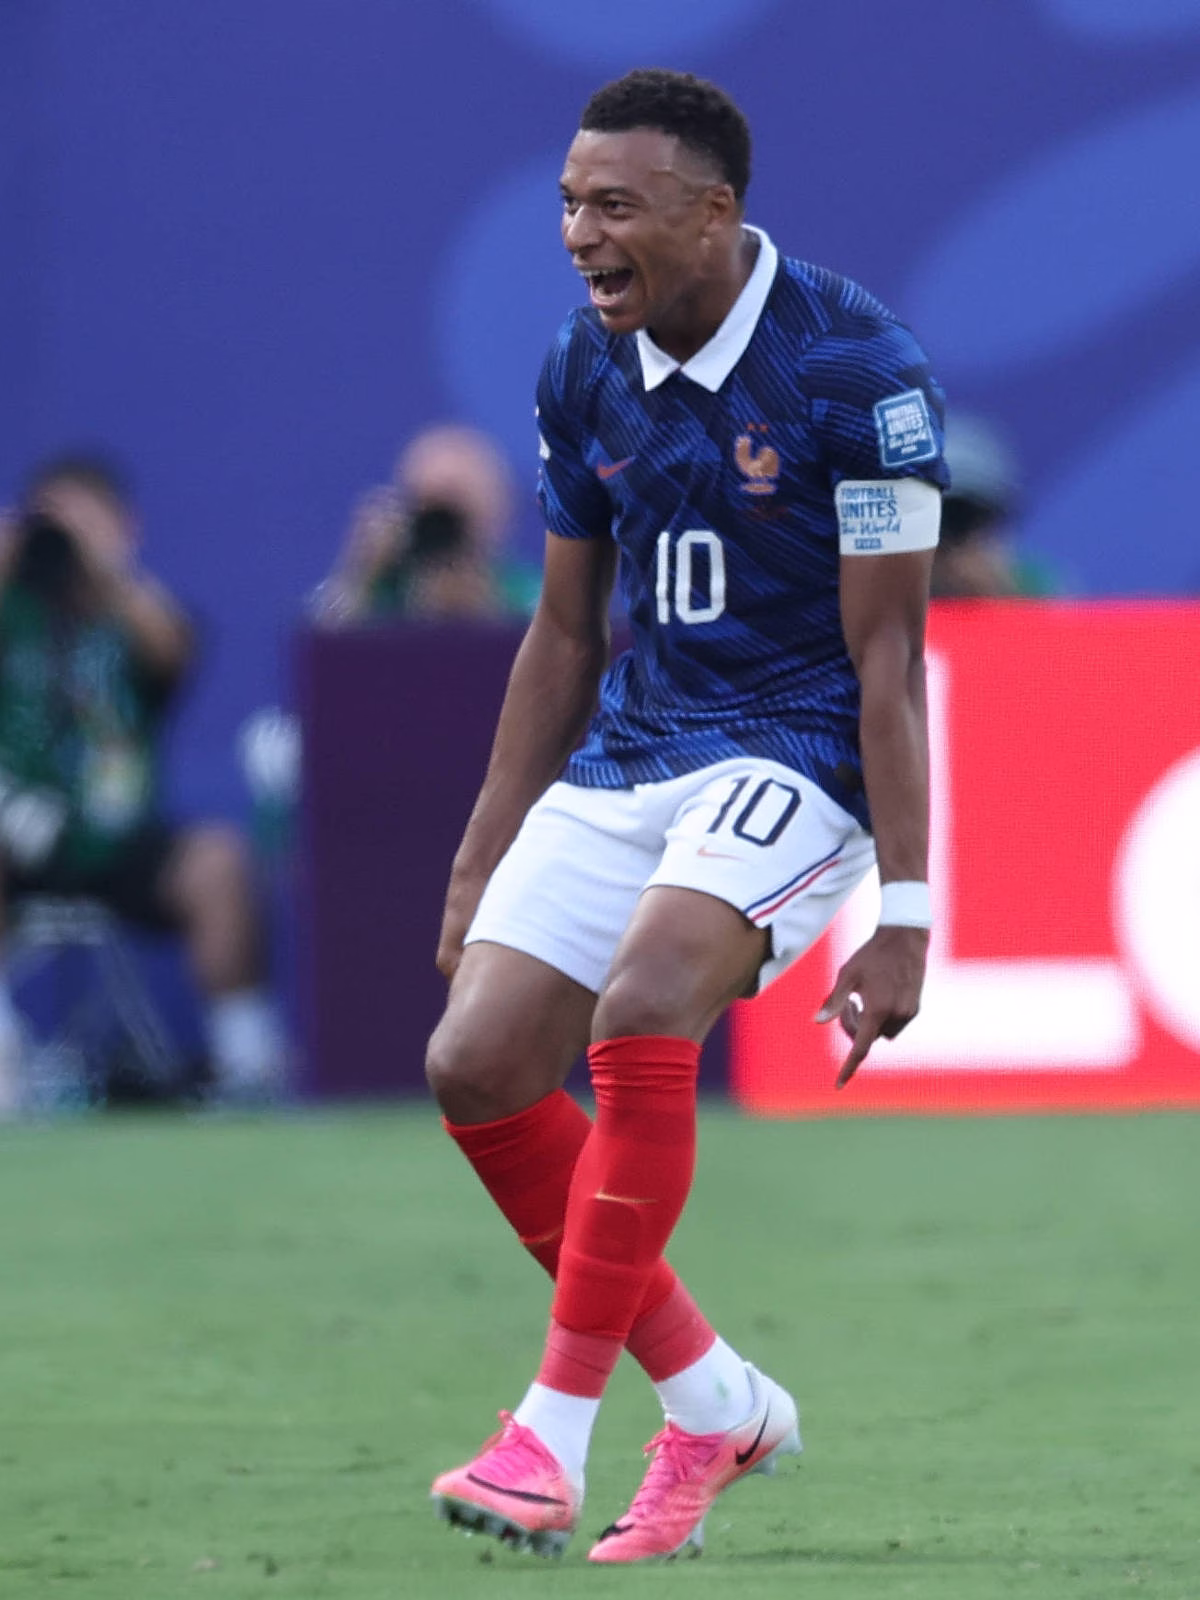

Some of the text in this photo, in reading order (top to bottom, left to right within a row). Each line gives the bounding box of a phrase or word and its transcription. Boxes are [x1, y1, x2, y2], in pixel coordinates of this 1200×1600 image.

[840, 500, 897, 518] UNITES
[656, 530, 726, 625] 10
[706, 775, 801, 847] 10
